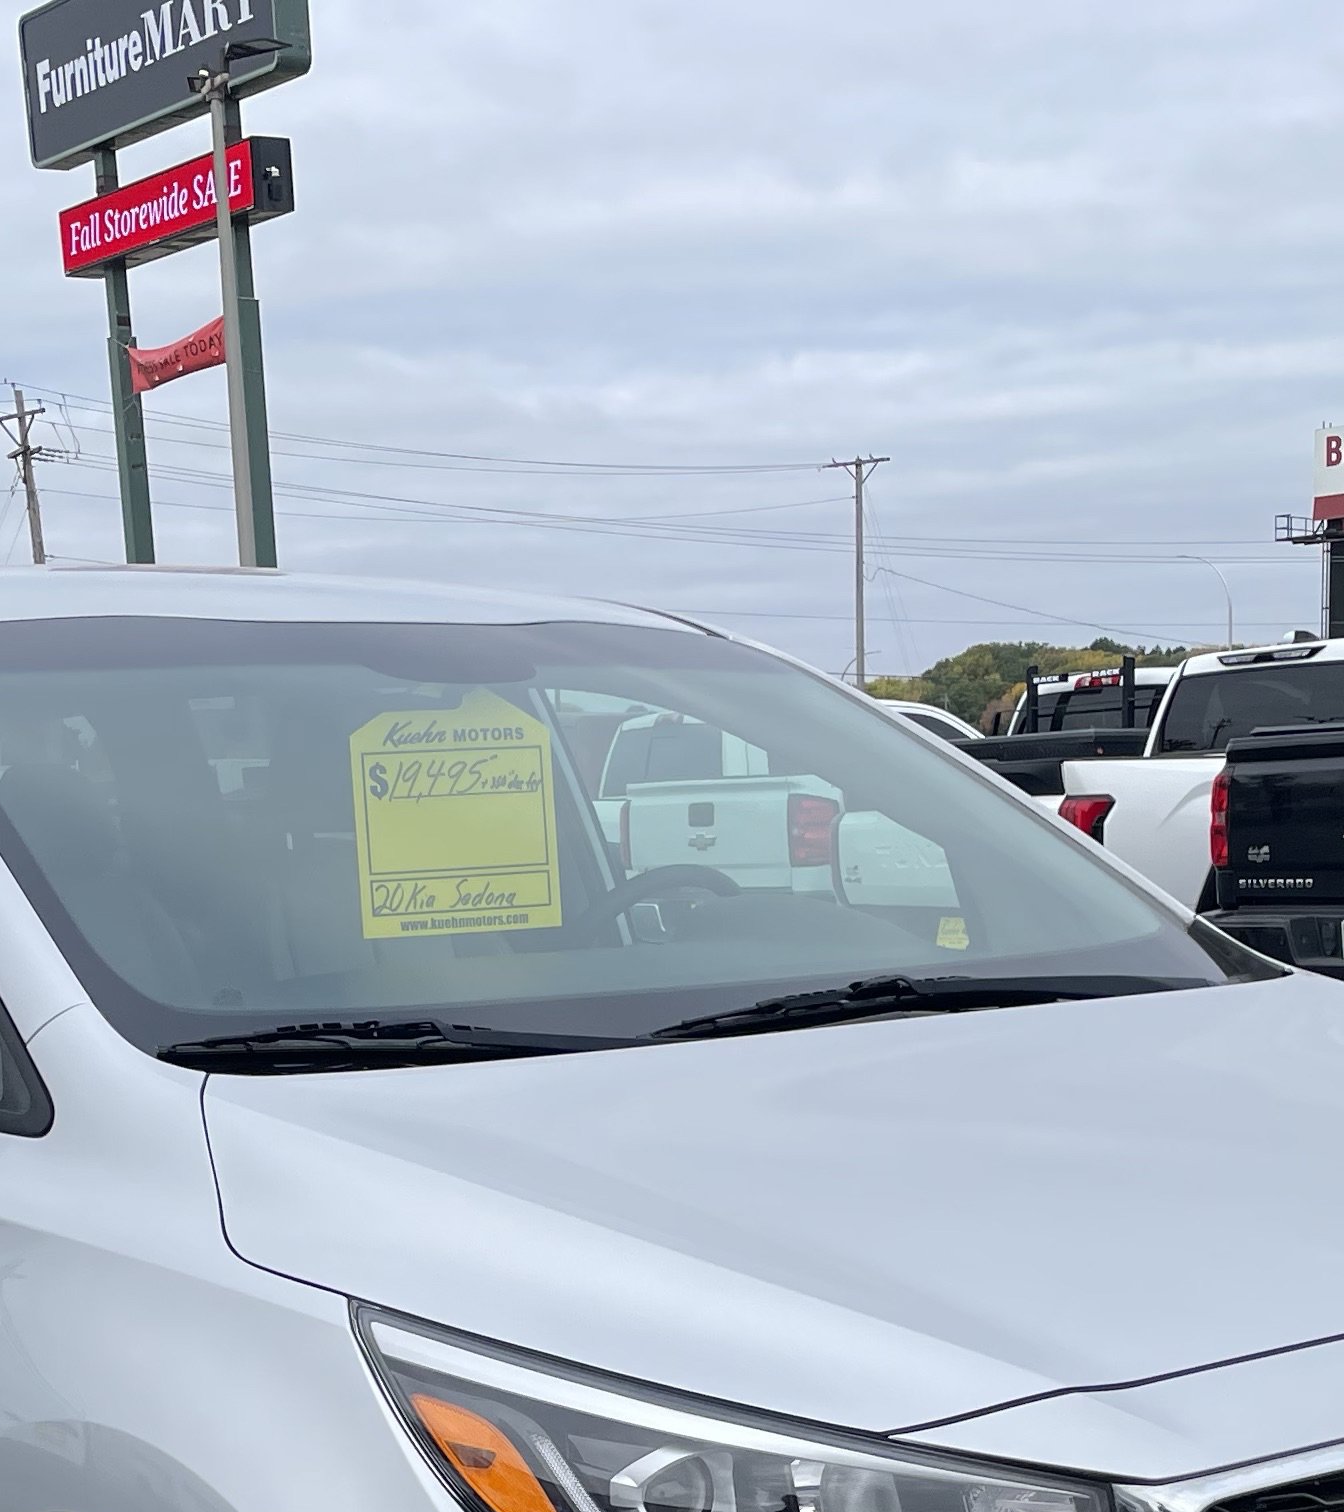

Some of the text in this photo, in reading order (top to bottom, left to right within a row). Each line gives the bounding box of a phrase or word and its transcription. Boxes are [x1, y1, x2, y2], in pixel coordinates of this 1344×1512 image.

[69, 159, 242, 256] Fall Storewide SAE
[183, 331, 223, 356] TODAY
[1092, 667, 1120, 677] RACK
[382, 720, 525, 748] Kuehn MOTORS
[405, 882, 437, 913] Kia
[449, 878, 517, 909] Sedona
[1238, 878, 1314, 889] SILVERADO
[400, 912, 530, 932] www.kuehnmotors.com
